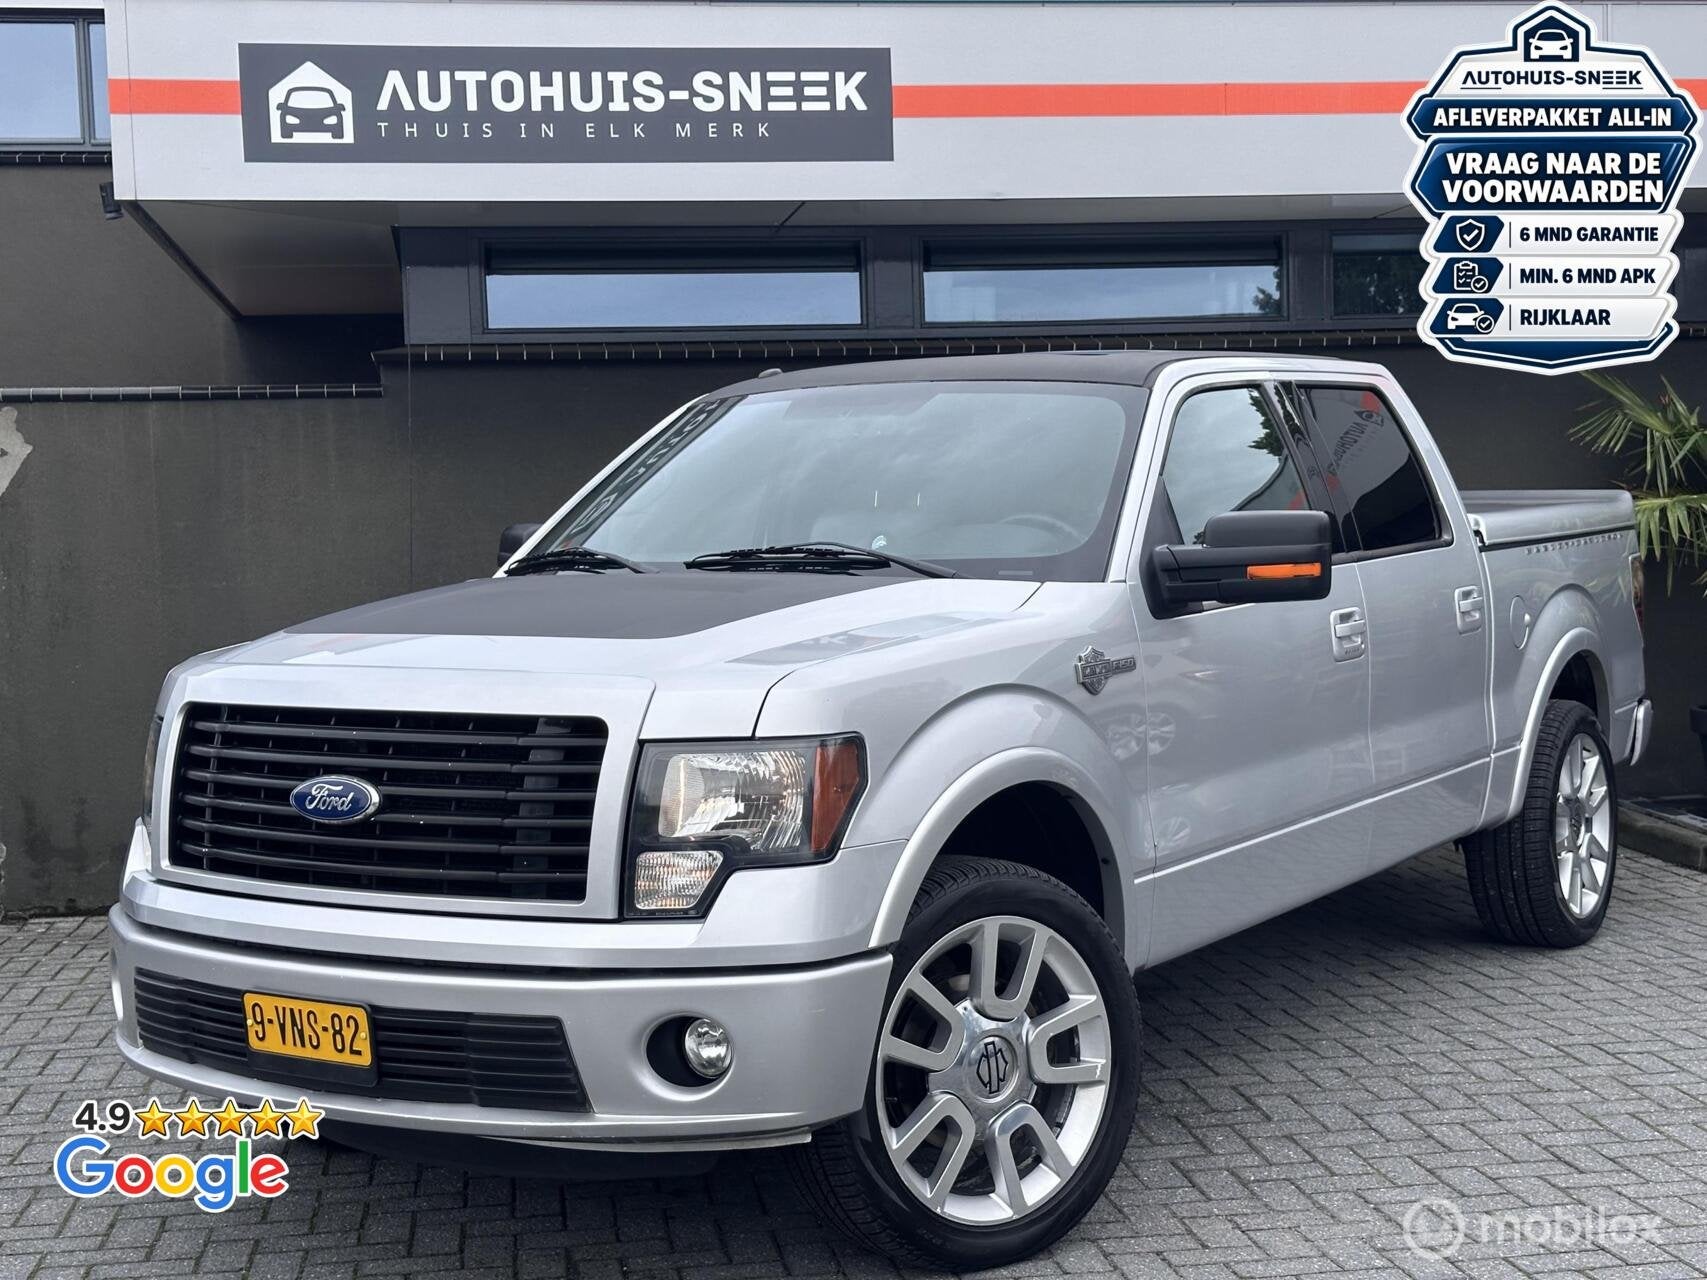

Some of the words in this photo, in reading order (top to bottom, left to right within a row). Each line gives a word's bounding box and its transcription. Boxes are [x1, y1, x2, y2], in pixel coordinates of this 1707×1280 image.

[376, 69, 868, 113] AUTOHUIS-SNEEK
[376, 122, 493, 138] THUIS
[519, 122, 555, 138] IN
[585, 122, 645, 138] ELK
[675, 122, 770, 138] MERK
[305, 783, 355, 811] Ford
[250, 1001, 363, 1057] 9-VNS-82
